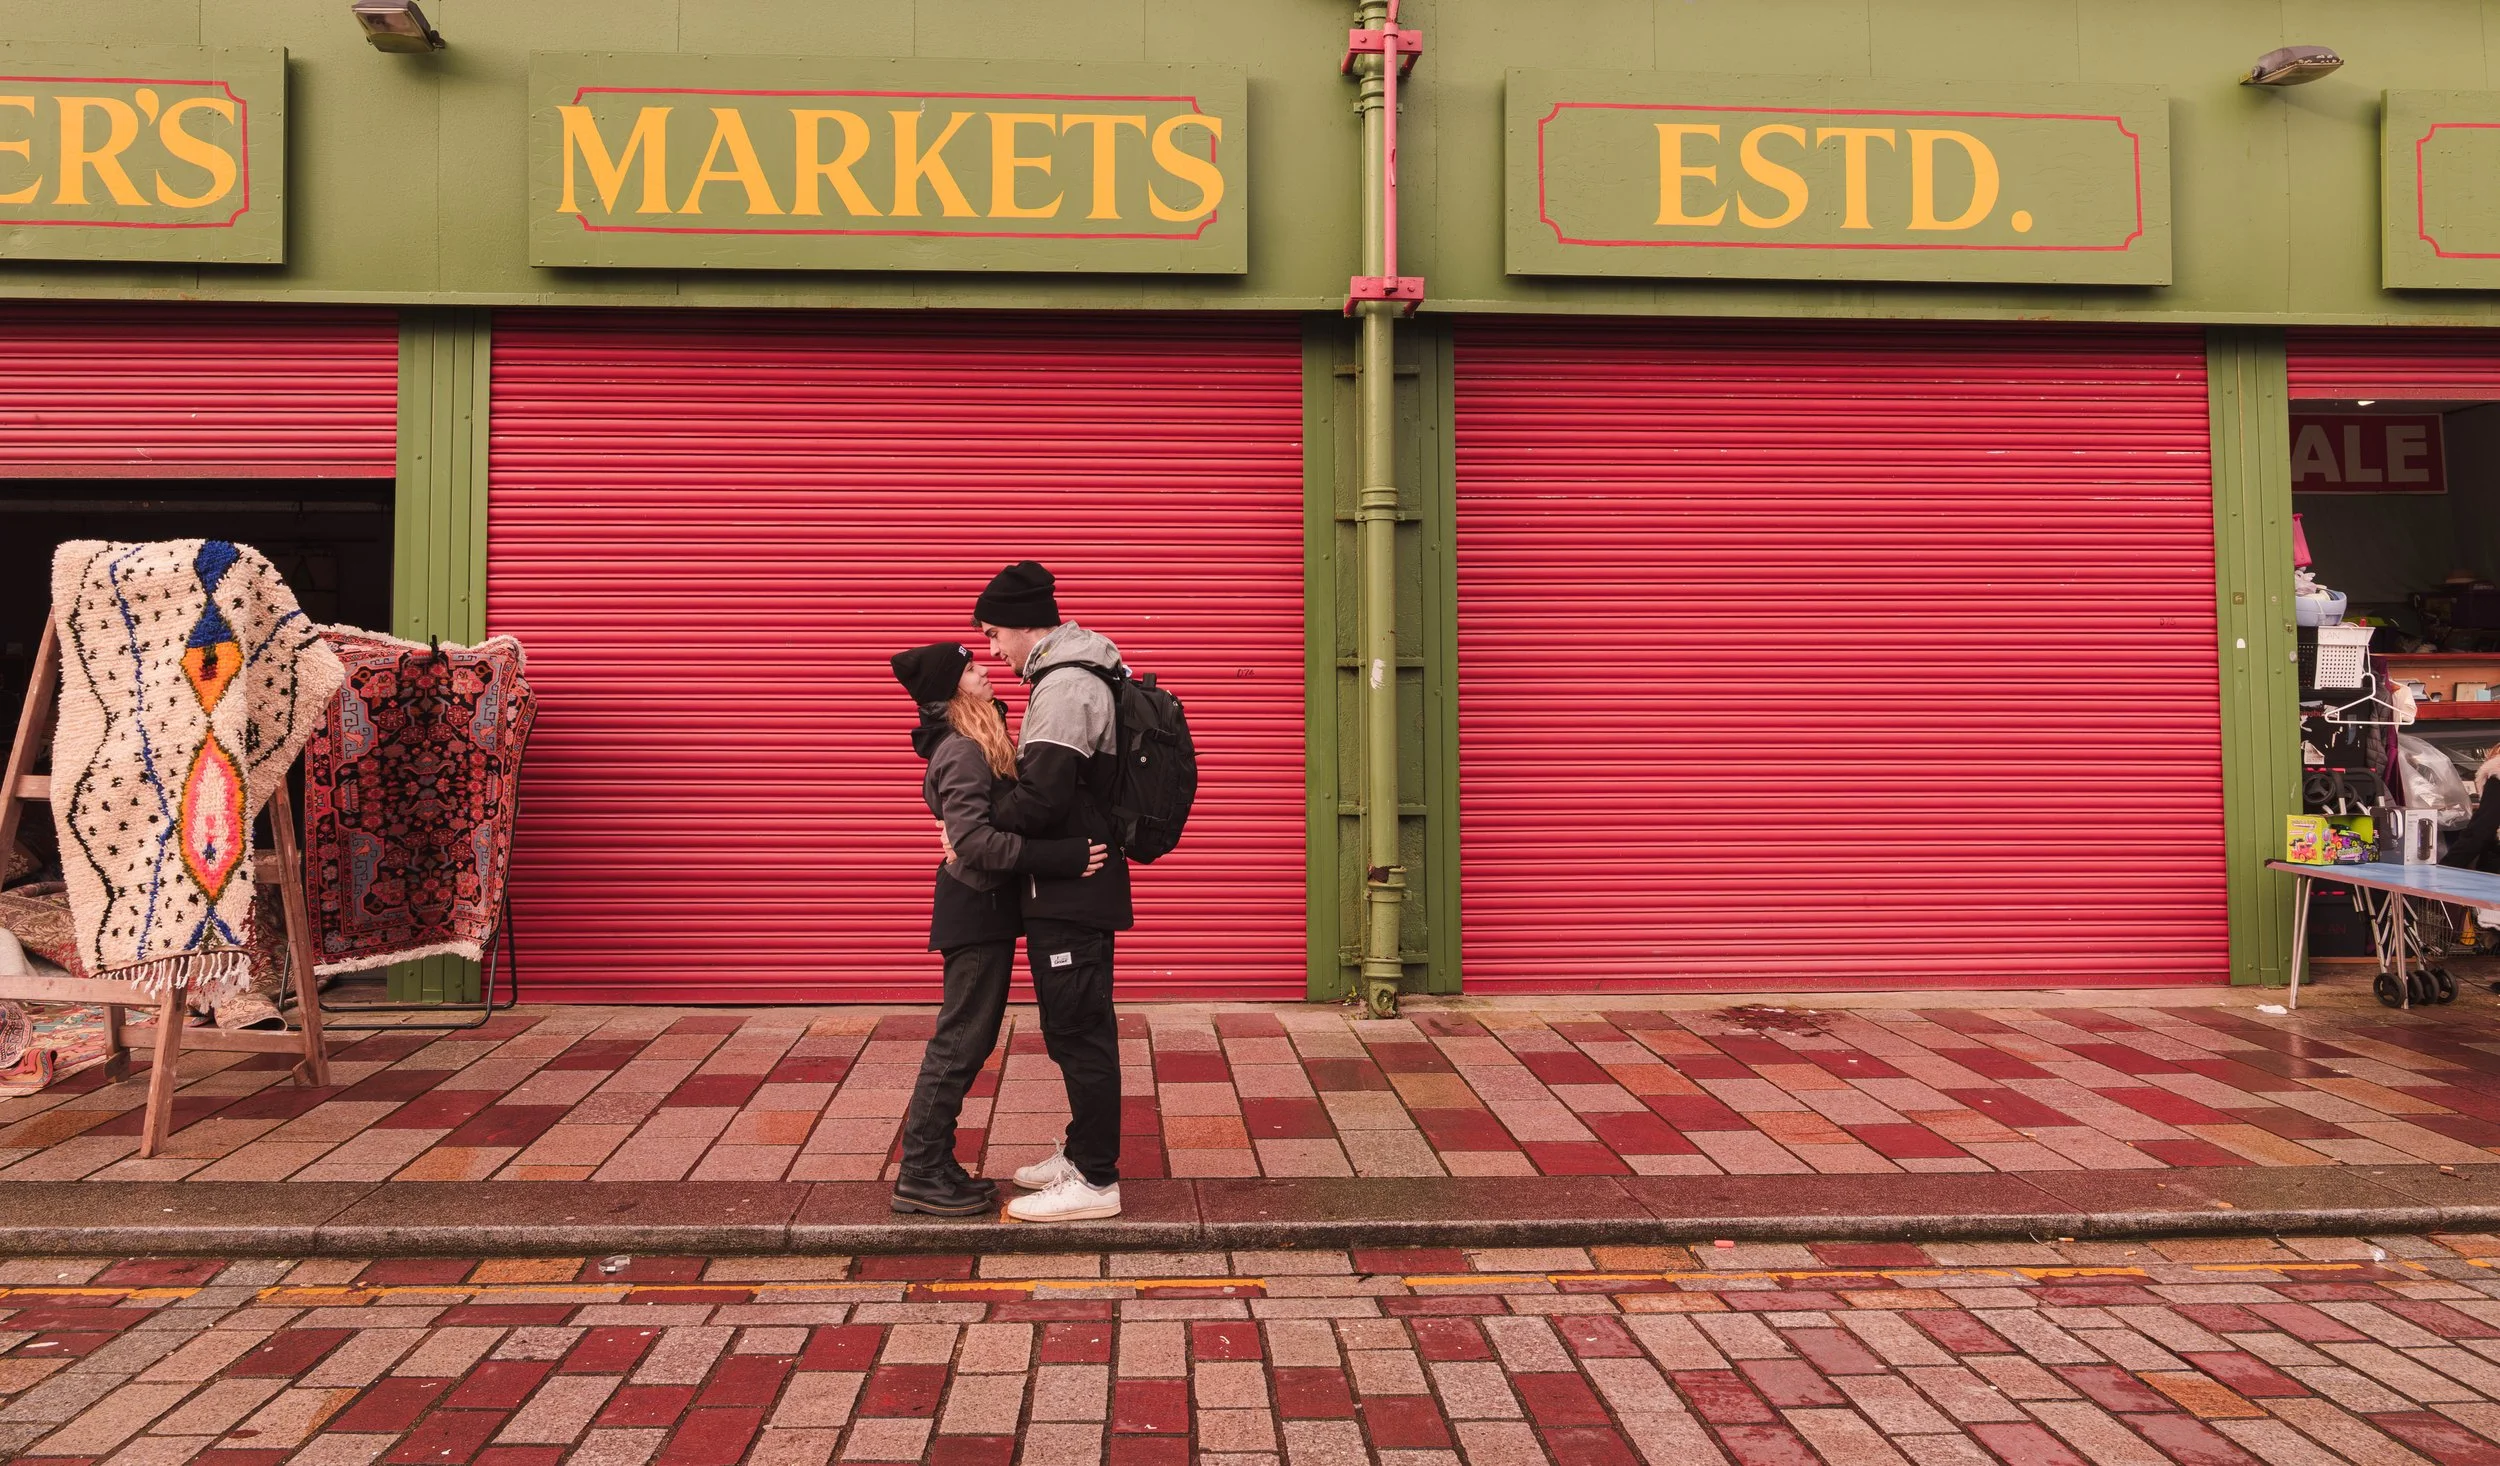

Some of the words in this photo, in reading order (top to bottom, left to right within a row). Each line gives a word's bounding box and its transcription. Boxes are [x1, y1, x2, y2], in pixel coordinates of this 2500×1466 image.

[556, 105, 1225, 222] MARKETS
[1653, 122, 2034, 233] ESTD.
[2291, 424, 2430, 482] ALE
